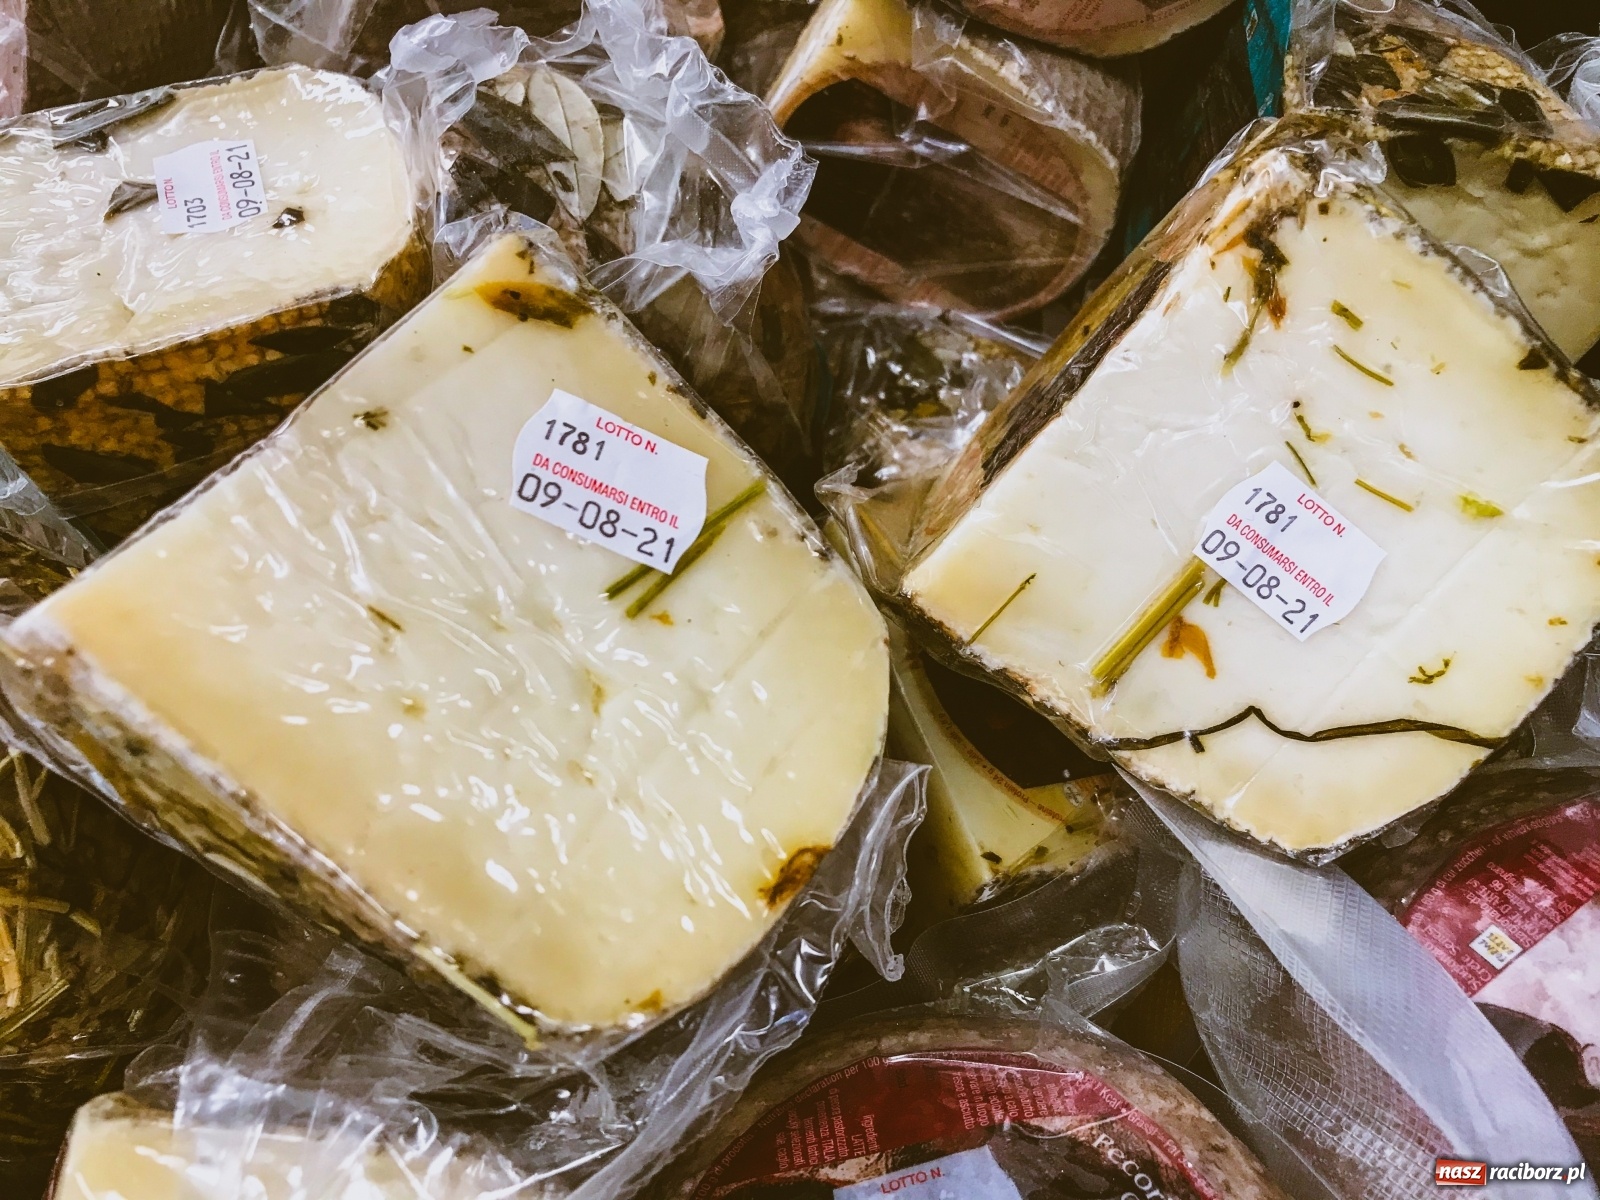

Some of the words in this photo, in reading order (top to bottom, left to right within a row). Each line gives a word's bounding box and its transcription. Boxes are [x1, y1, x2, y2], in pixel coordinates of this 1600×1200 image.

[163, 184, 177, 209] LOTTO
[212, 172, 231, 211] CONSUMARSI
[226, 145, 261, 218] 09-08-21
[184, 198, 206, 228] 1703
[221, 211, 232, 220] DA
[544, 419, 605, 461] 1781
[595, 417, 643, 447] LOTTO
[644, 440, 658, 455] N.
[532, 453, 549, 471] DA
[552, 462, 629, 506] CONSUMARSI
[629, 497, 668, 523] ENTRO
[669, 515, 679, 529] IL
[517, 473, 675, 563] 09-08-21
[1244, 487, 1298, 532] 1781
[1297, 493, 1335, 526] LOTTO
[1332, 523, 1346, 538] N.
[1226, 514, 1242, 531] DA
[1240, 524, 1298, 575] CONSUMARSI
[1294, 569, 1325, 599] ENTRO
[1322, 594, 1335, 607] IL
[1201, 529, 1319, 633] 09-08-21
[992, 774, 1003, 784] 24
[1003, 783, 1030, 804] Protein
[1488, 877, 1505, 893] 66
[795, 1072, 843, 1104] declaration
[843, 1065, 859, 1079] per
[861, 1056, 880, 1069] 100
[958, 1097, 976, 1130] asciutto
[973, 1101, 992, 1127] luogo
[1100, 1086, 1120, 1110] Kcal
[821, 1138, 836, 1162] ITALIA
[850, 1133, 865, 1156] LATTE
[880, 1171, 927, 1194] LOTTO
[930, 1167, 945, 1179] N.
